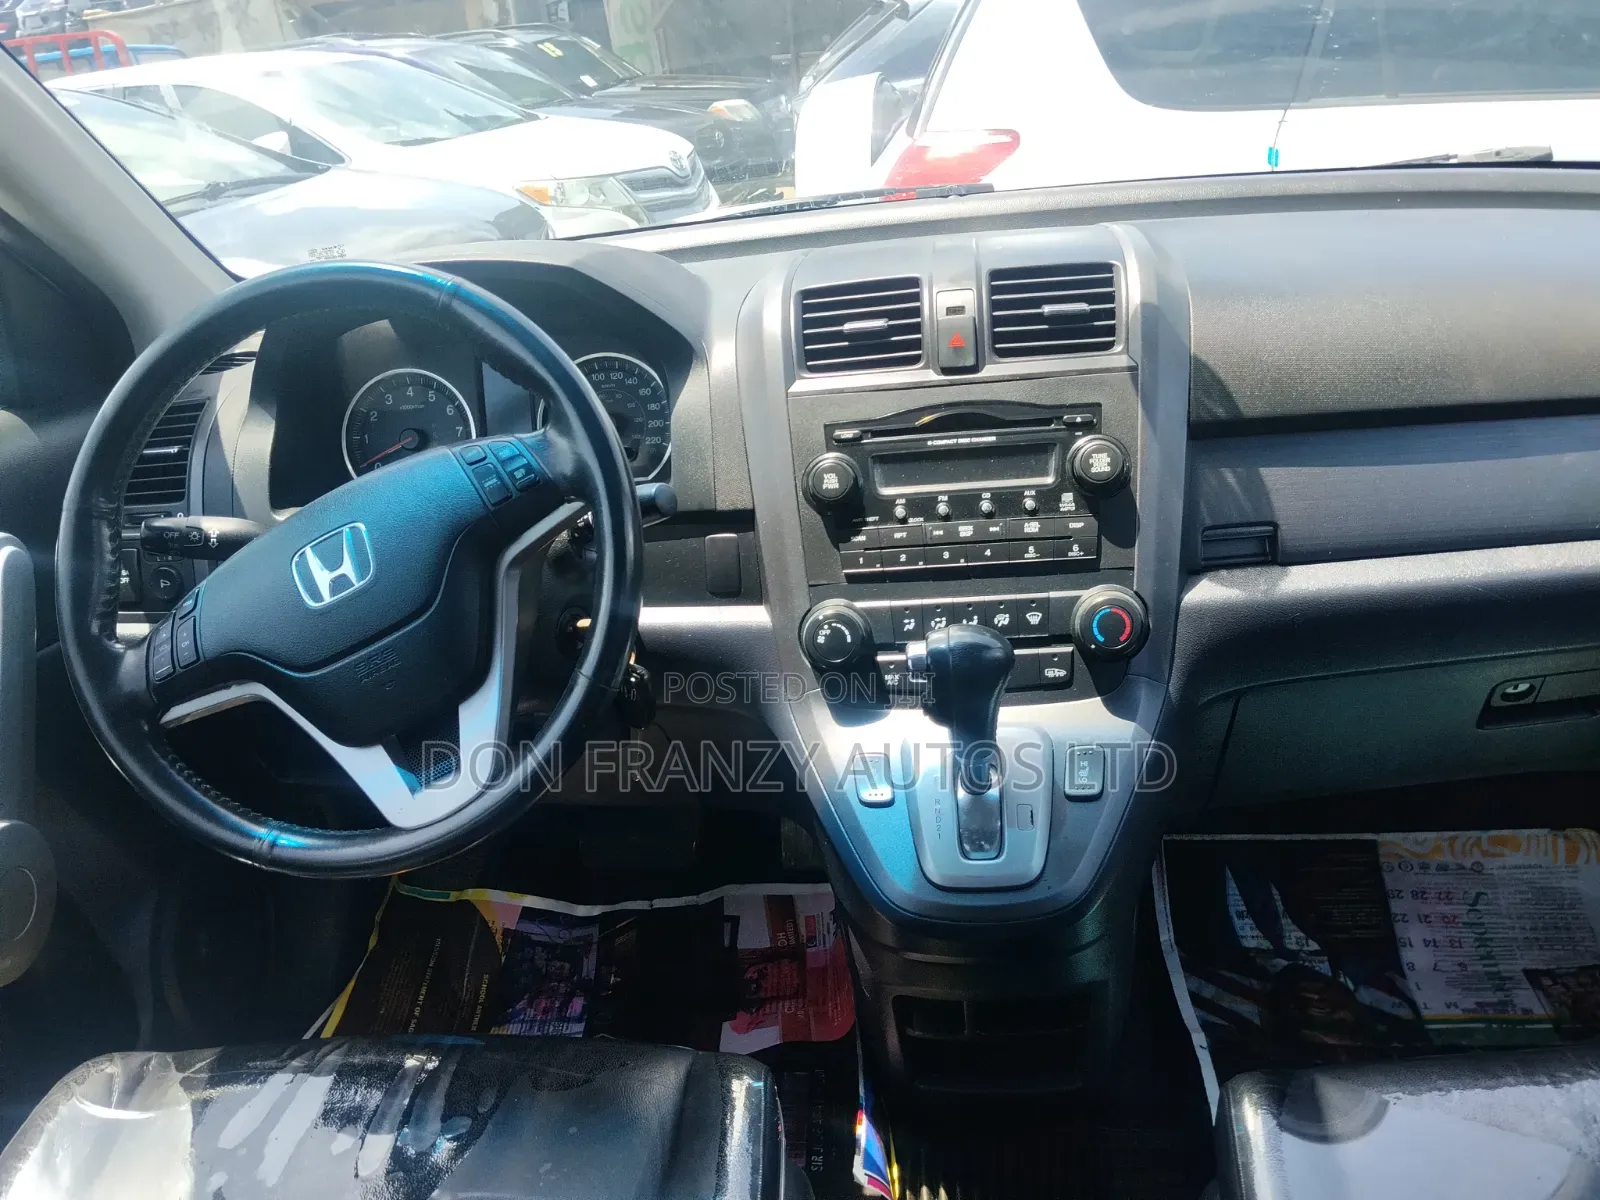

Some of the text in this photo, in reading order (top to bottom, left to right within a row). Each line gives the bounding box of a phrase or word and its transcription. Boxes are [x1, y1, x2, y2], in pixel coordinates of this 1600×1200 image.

[592, 373, 605, 381] 100
[610, 372, 624, 380] 120
[624, 377, 638, 386] 140
[406, 386, 414, 397] 4
[428, 390, 436, 402] 5
[638, 388, 652, 396] 160
[385, 394, 393, 404] 3
[446, 404, 454, 416] 6
[646, 402, 660, 410] 180
[370, 411, 378, 422] 2
[648, 420, 664, 428] 200
[456, 426, 463, 438] 7
[364, 434, 369, 444] 1
[645, 436, 662, 444] 220
[822, 482, 839, 490] PWR
[1028, 546, 1035, 554] 5
[1072, 544, 1080, 552] 6
[182, 640, 190, 648] CH
[934, 798, 940, 806] R
[936, 816, 942, 824] D
[936, 824, 942, 832] 2
[938, 832, 940, 840] 1
[1387, 888, 1404, 900] 29
[1409, 889, 1430, 900] 28
[1391, 913, 1460, 924] 20 21 22
[1398, 937, 1414, 948] 15
[1422, 938, 1439, 948] 14
[1406, 962, 1416, 972] 8
[1432, 962, 1442, 972] 7
[416, 967, 434, 1006] STATEMENT
[478, 973, 490, 1003] SCHOOL
[412, 1006, 422, 1018] OF
[810, 1155, 824, 1172] SIR
